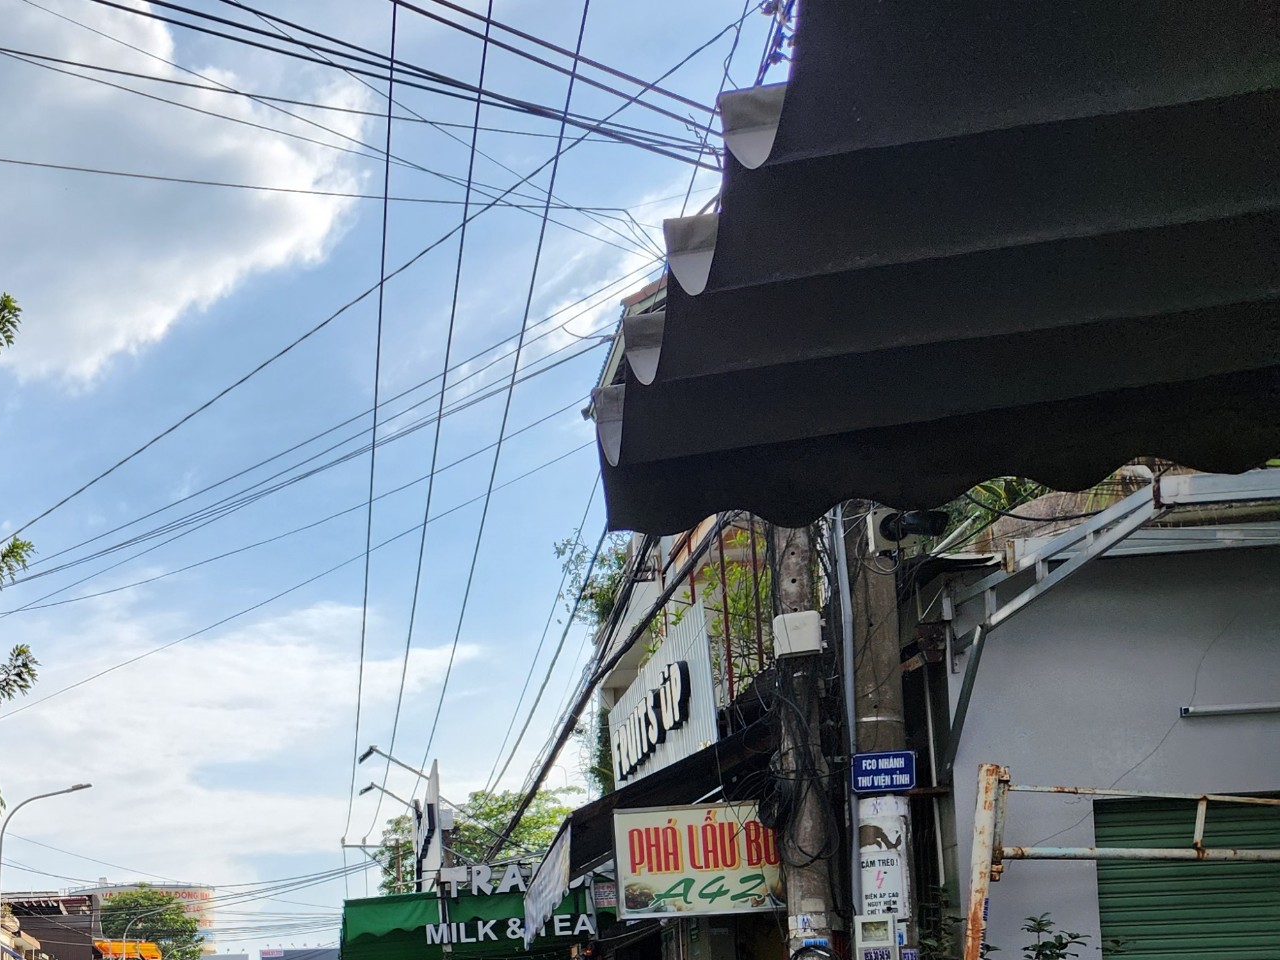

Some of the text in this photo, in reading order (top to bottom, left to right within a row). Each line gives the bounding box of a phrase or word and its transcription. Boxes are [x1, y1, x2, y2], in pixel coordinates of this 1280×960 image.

[613, 689, 660, 781] FRUITS
[878, 756, 905, 769] NHÁNH
[857, 770, 910, 788] THƯ VIỆN TỈNH
[628, 818, 682, 875] PHÁ
[687, 810, 740, 869] LẤU
[650, 874, 766, 905] A42
[426, 914, 595, 945] MILK & EA
